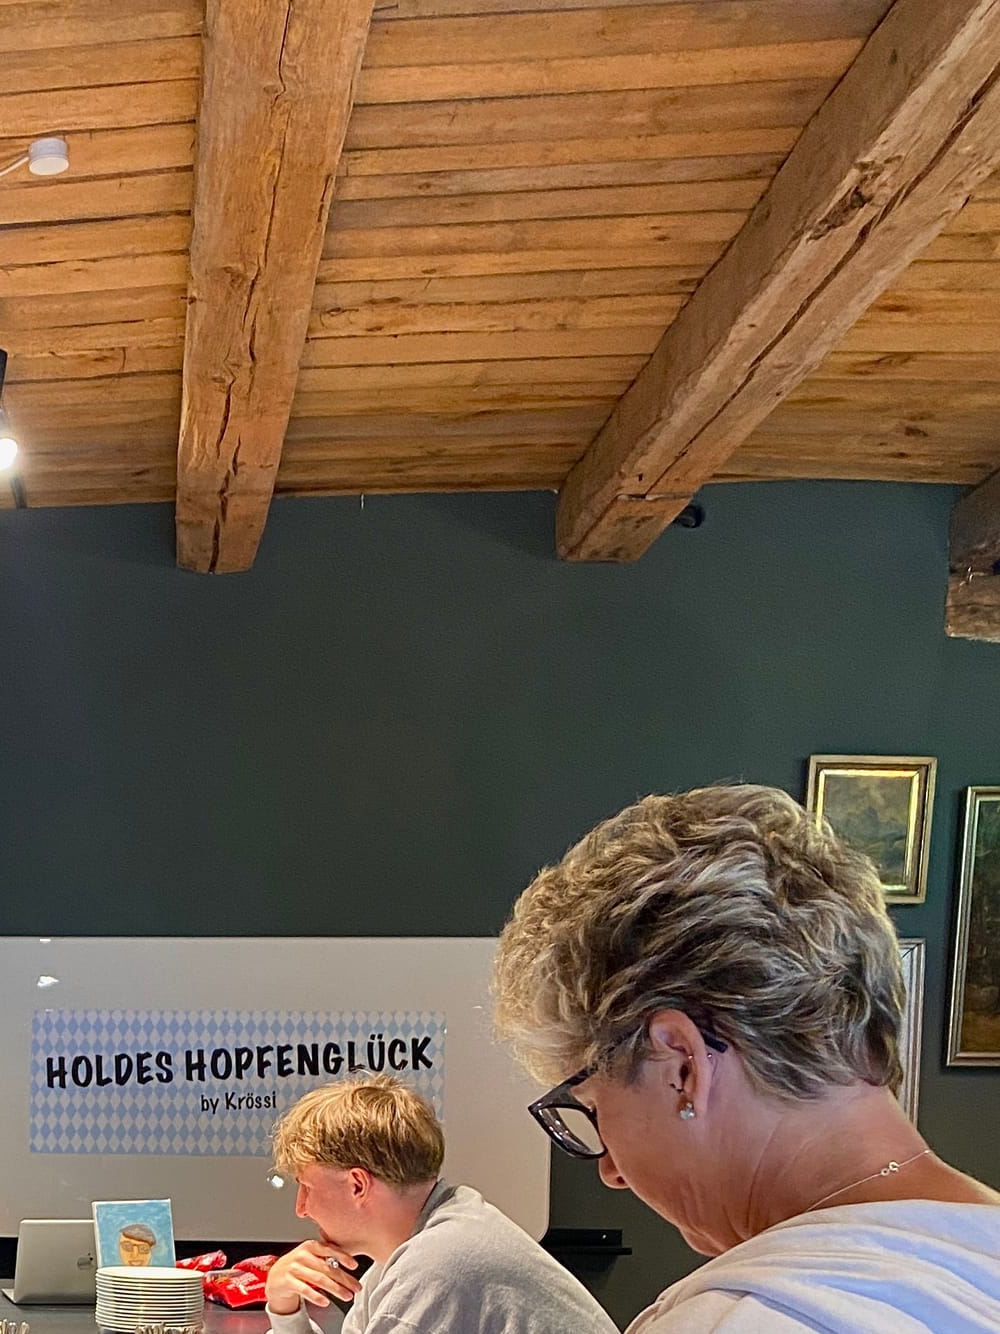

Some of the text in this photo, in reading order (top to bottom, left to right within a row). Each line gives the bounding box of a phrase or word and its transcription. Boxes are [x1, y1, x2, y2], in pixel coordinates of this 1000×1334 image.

[46, 1034, 434, 1089] HOLDES HOPFENGLÜCK
[200, 1091, 277, 1114] by Krössi
